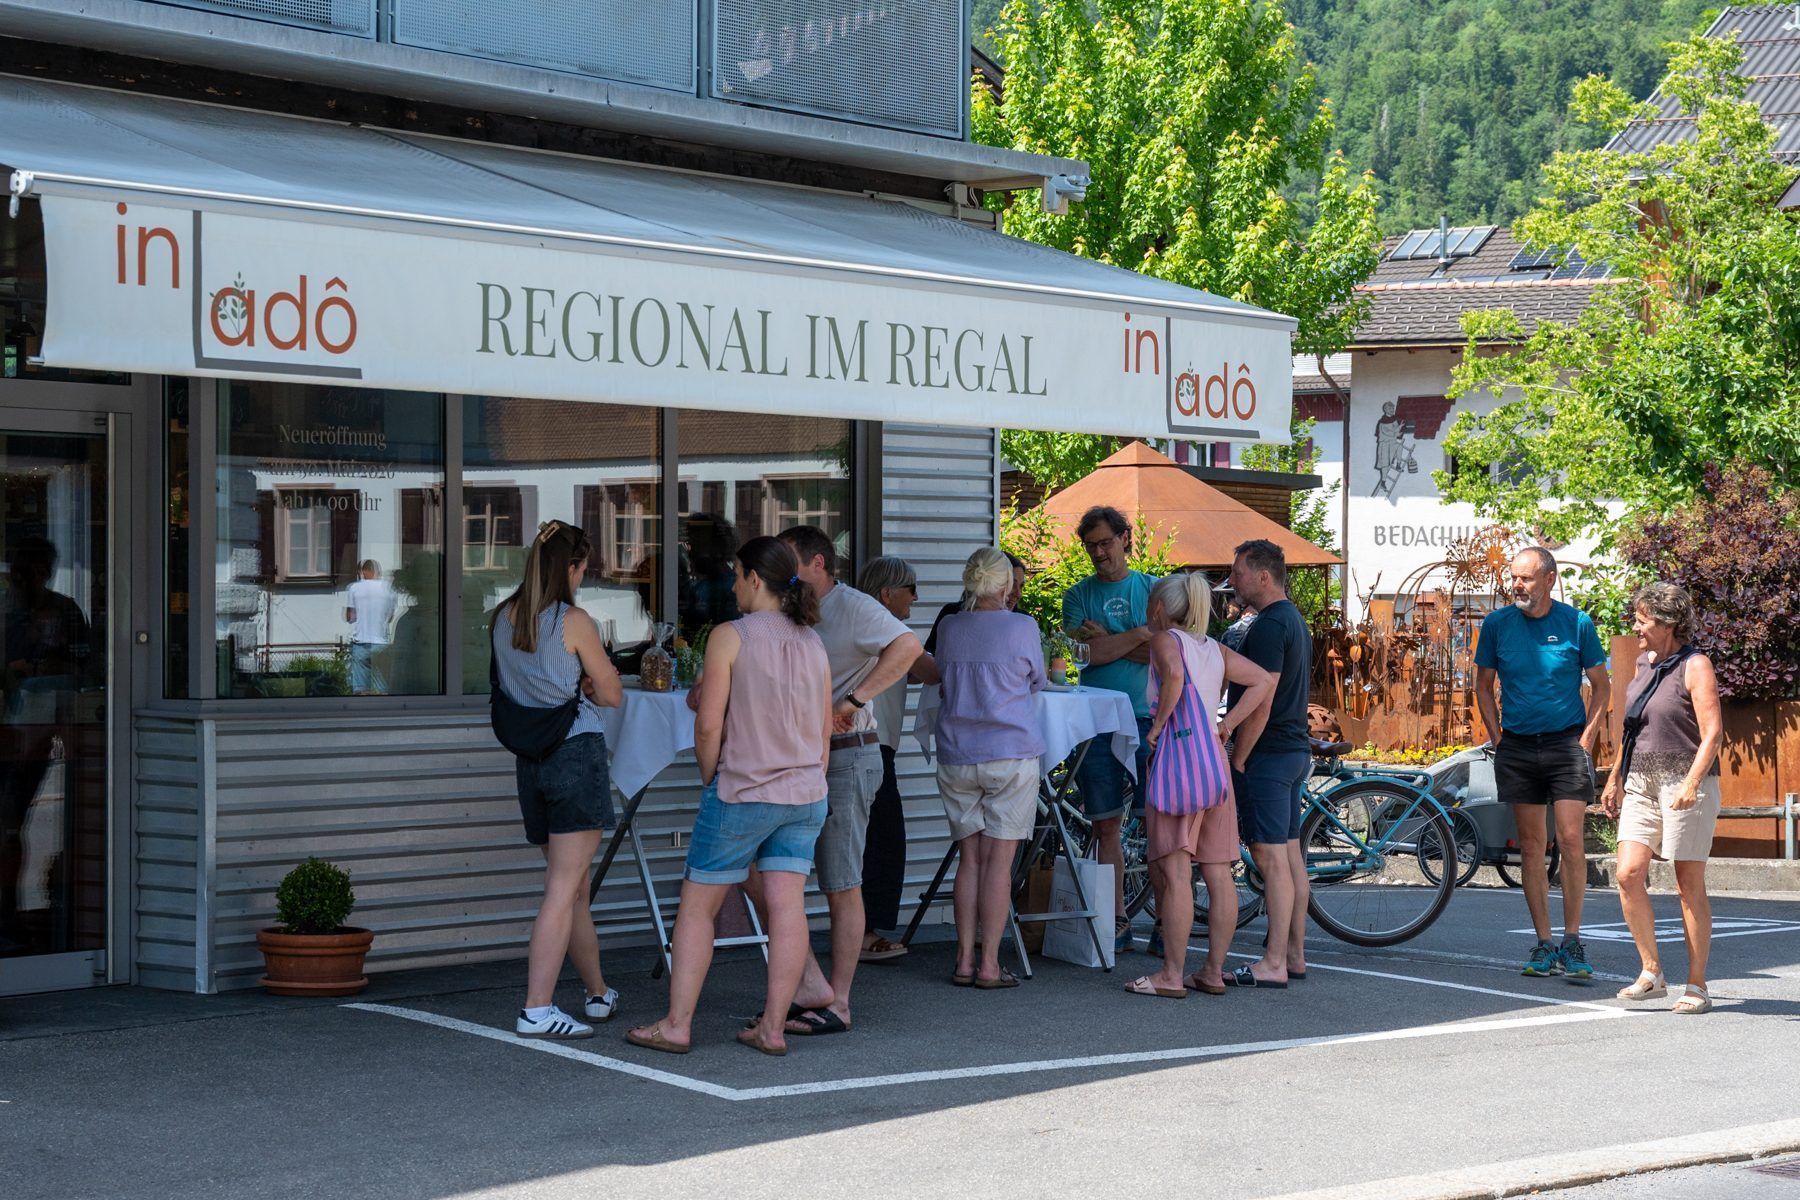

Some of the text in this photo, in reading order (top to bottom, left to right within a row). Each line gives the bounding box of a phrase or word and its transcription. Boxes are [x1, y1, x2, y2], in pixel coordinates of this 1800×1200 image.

[116, 201, 358, 355] in adô
[475, 281, 1048, 397] REGIONAL IM REGAL
[1123, 311, 1257, 421] in adô
[278, 423, 388, 450] Neueröffnung
[326, 458, 357, 478] Mai
[359, 461, 396, 480] 2026
[284, 488, 304, 510] ab
[352, 490, 383, 513] Uhr
